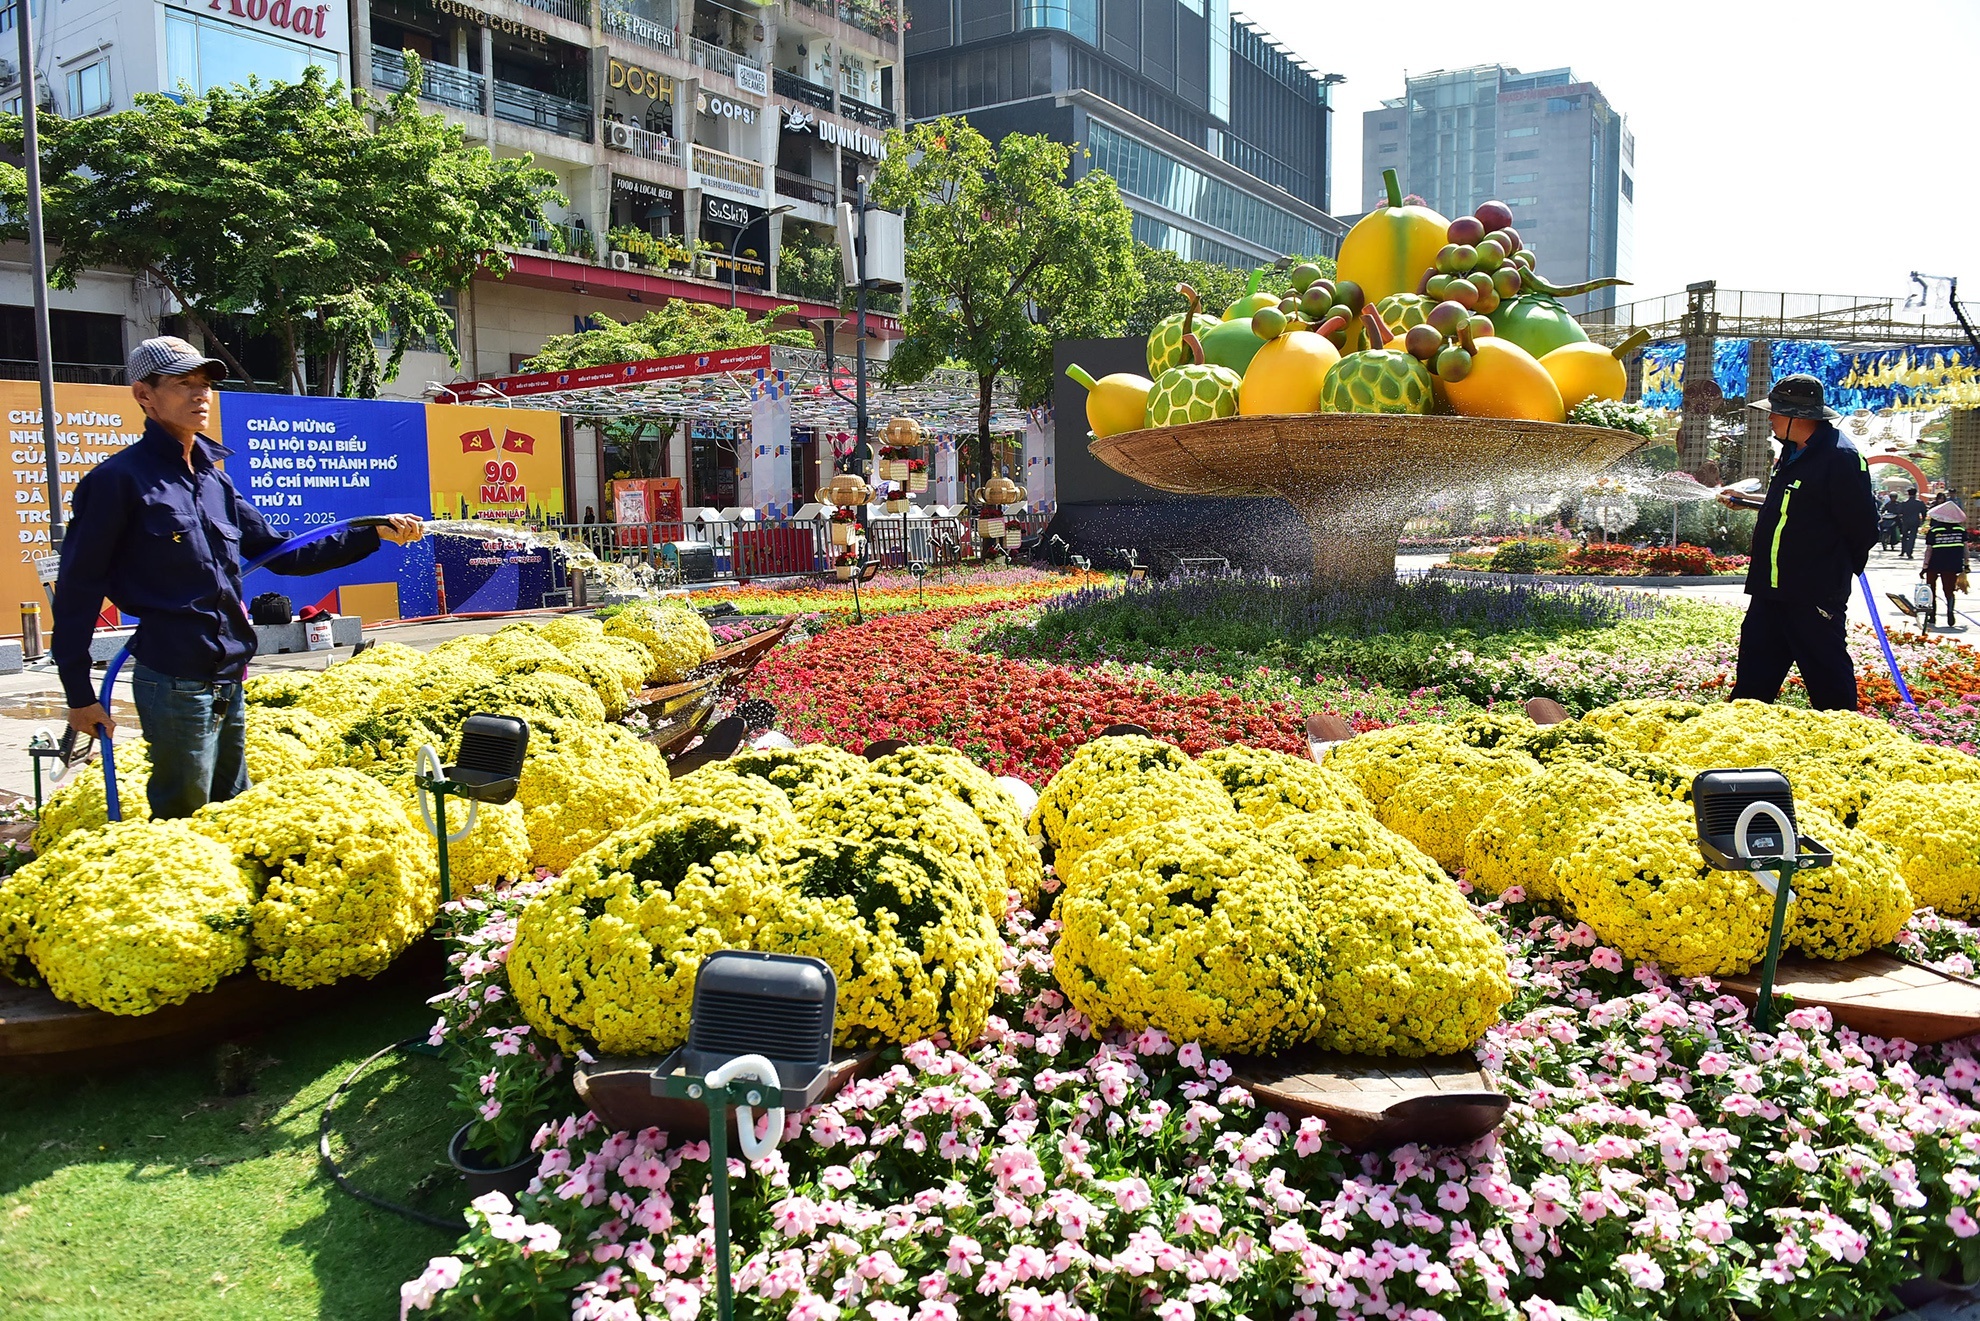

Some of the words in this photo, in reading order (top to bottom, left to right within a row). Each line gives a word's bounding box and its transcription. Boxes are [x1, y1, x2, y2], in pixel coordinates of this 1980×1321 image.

[490, 13, 548, 45] COFFEE
[608, 59, 675, 106] DOSH
[711, 98, 755, 125] OOPS!
[616, 179, 634, 191] FOOD
[633, 182, 640, 192] &
[639, 184, 657, 197] LOCAL
[658, 189, 673, 200] BEER
[8, 408, 62, 425] CHÀO
[67, 410, 122, 426] MỪNG
[247, 417, 290, 432] CHÀO
[292, 418, 336, 433] MỪNG
[83, 430, 144, 446] THÀNH
[248, 438, 276, 453] ĐẠI
[278, 436, 305, 453] HỘI
[307, 439, 333, 454] ĐẠI
[336, 435, 367, 452] BIỂU
[11, 446, 47, 464] CỦA
[249, 453, 293, 470] ĐẢNG
[296, 455, 317, 472] BỘ
[319, 455, 368, 470] THÀNH
[370, 454, 398, 470] PHỐ
[13, 467, 80, 484] THÀNH
[250, 471, 274, 488] HỒ
[276, 473, 301, 488] CHÍ
[304, 476, 340, 488] MINH
[342, 471, 370, 488] LẦN
[484, 460, 518, 483] 90
[15, 487, 45, 503] ĐÃ
[252, 492, 284, 507] THỨ
[287, 494, 302, 506] XI
[480, 481, 526, 504] NĂM
[16, 510, 74, 523] TRON
[263, 513, 290, 525] 020
[303, 512, 336, 525] 2025
[478, 509, 508, 520] THÀNH
[508, 509, 526, 520] LẬP
